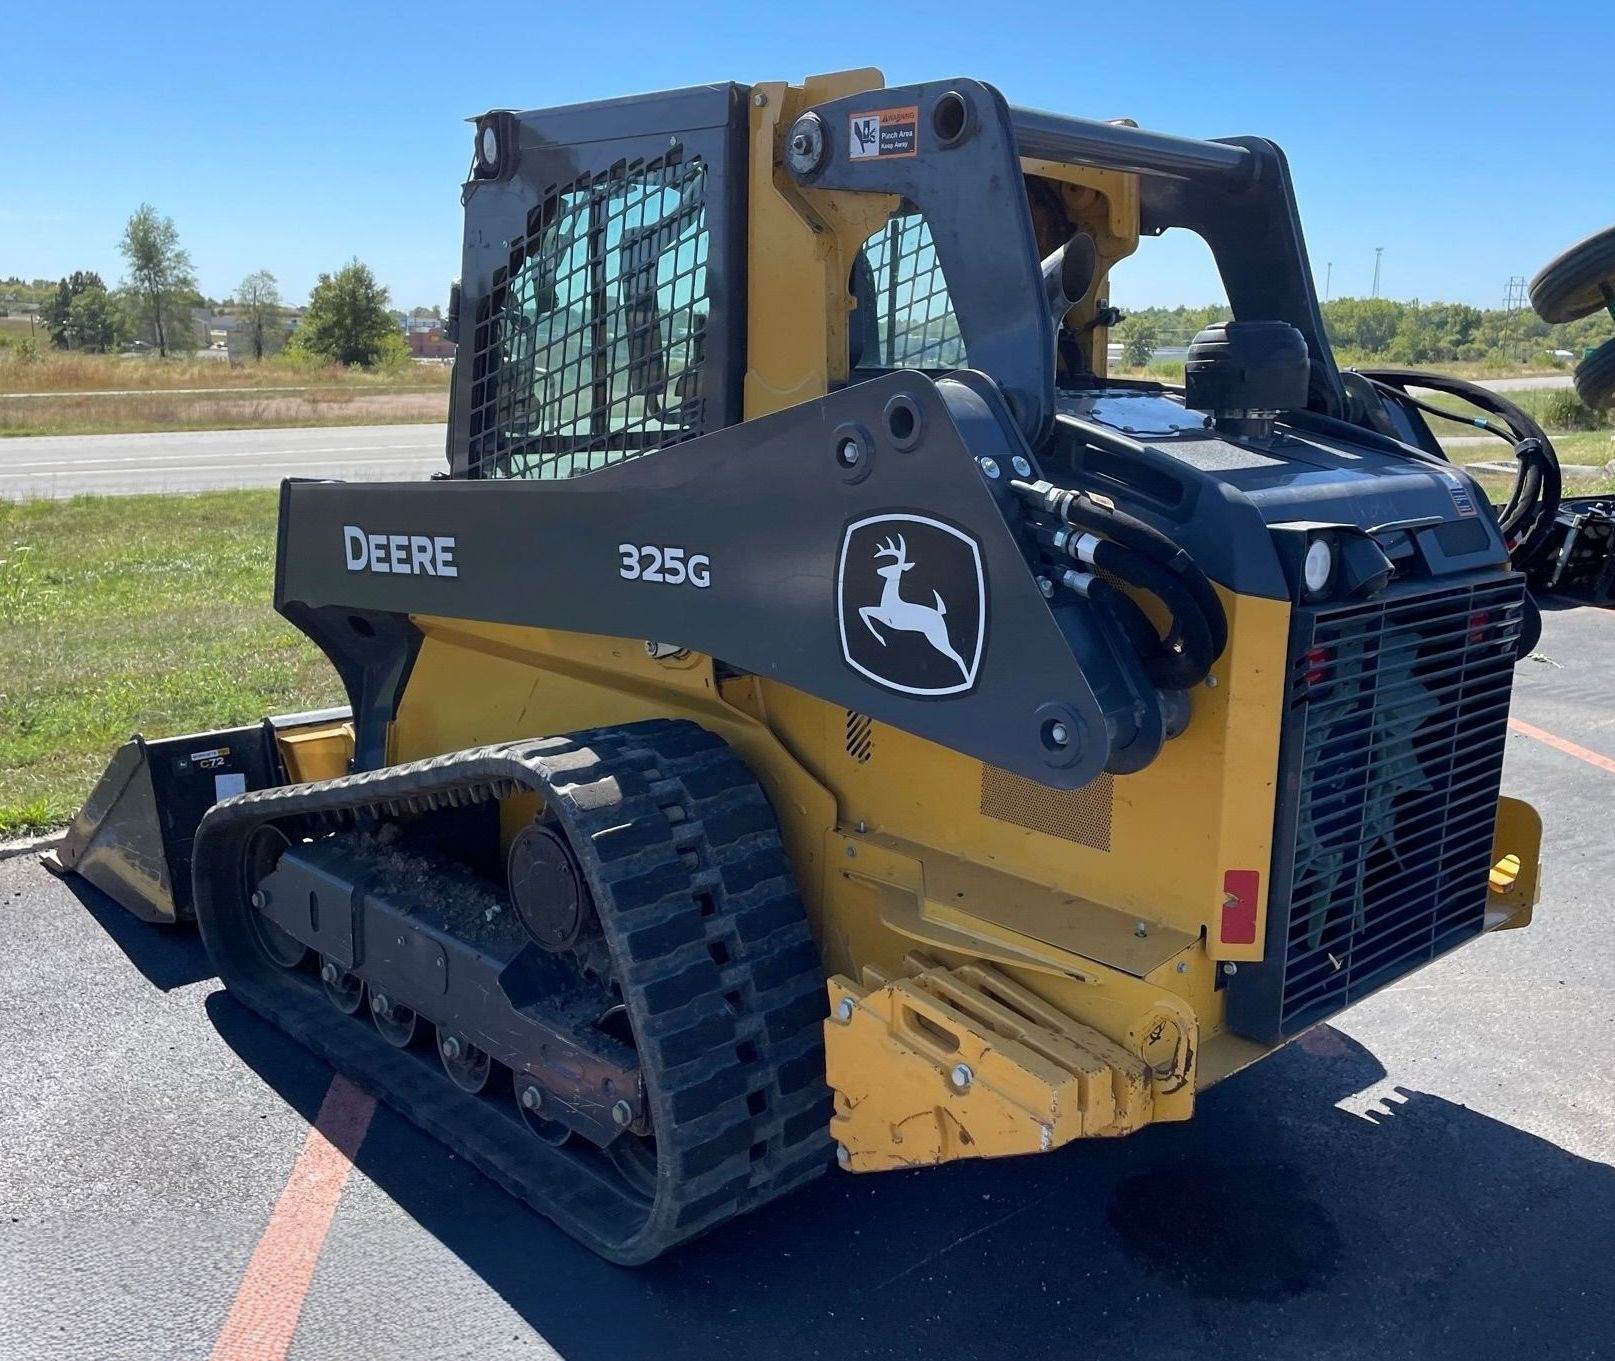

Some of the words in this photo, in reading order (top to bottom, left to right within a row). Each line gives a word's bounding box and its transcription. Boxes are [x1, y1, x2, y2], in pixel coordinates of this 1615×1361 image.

[881, 131, 898, 140] Pinch
[898, 130, 913, 138] Area
[894, 141, 908, 149] Away
[343, 525, 458, 577] DEERE
[618, 543, 711, 588] 325G
